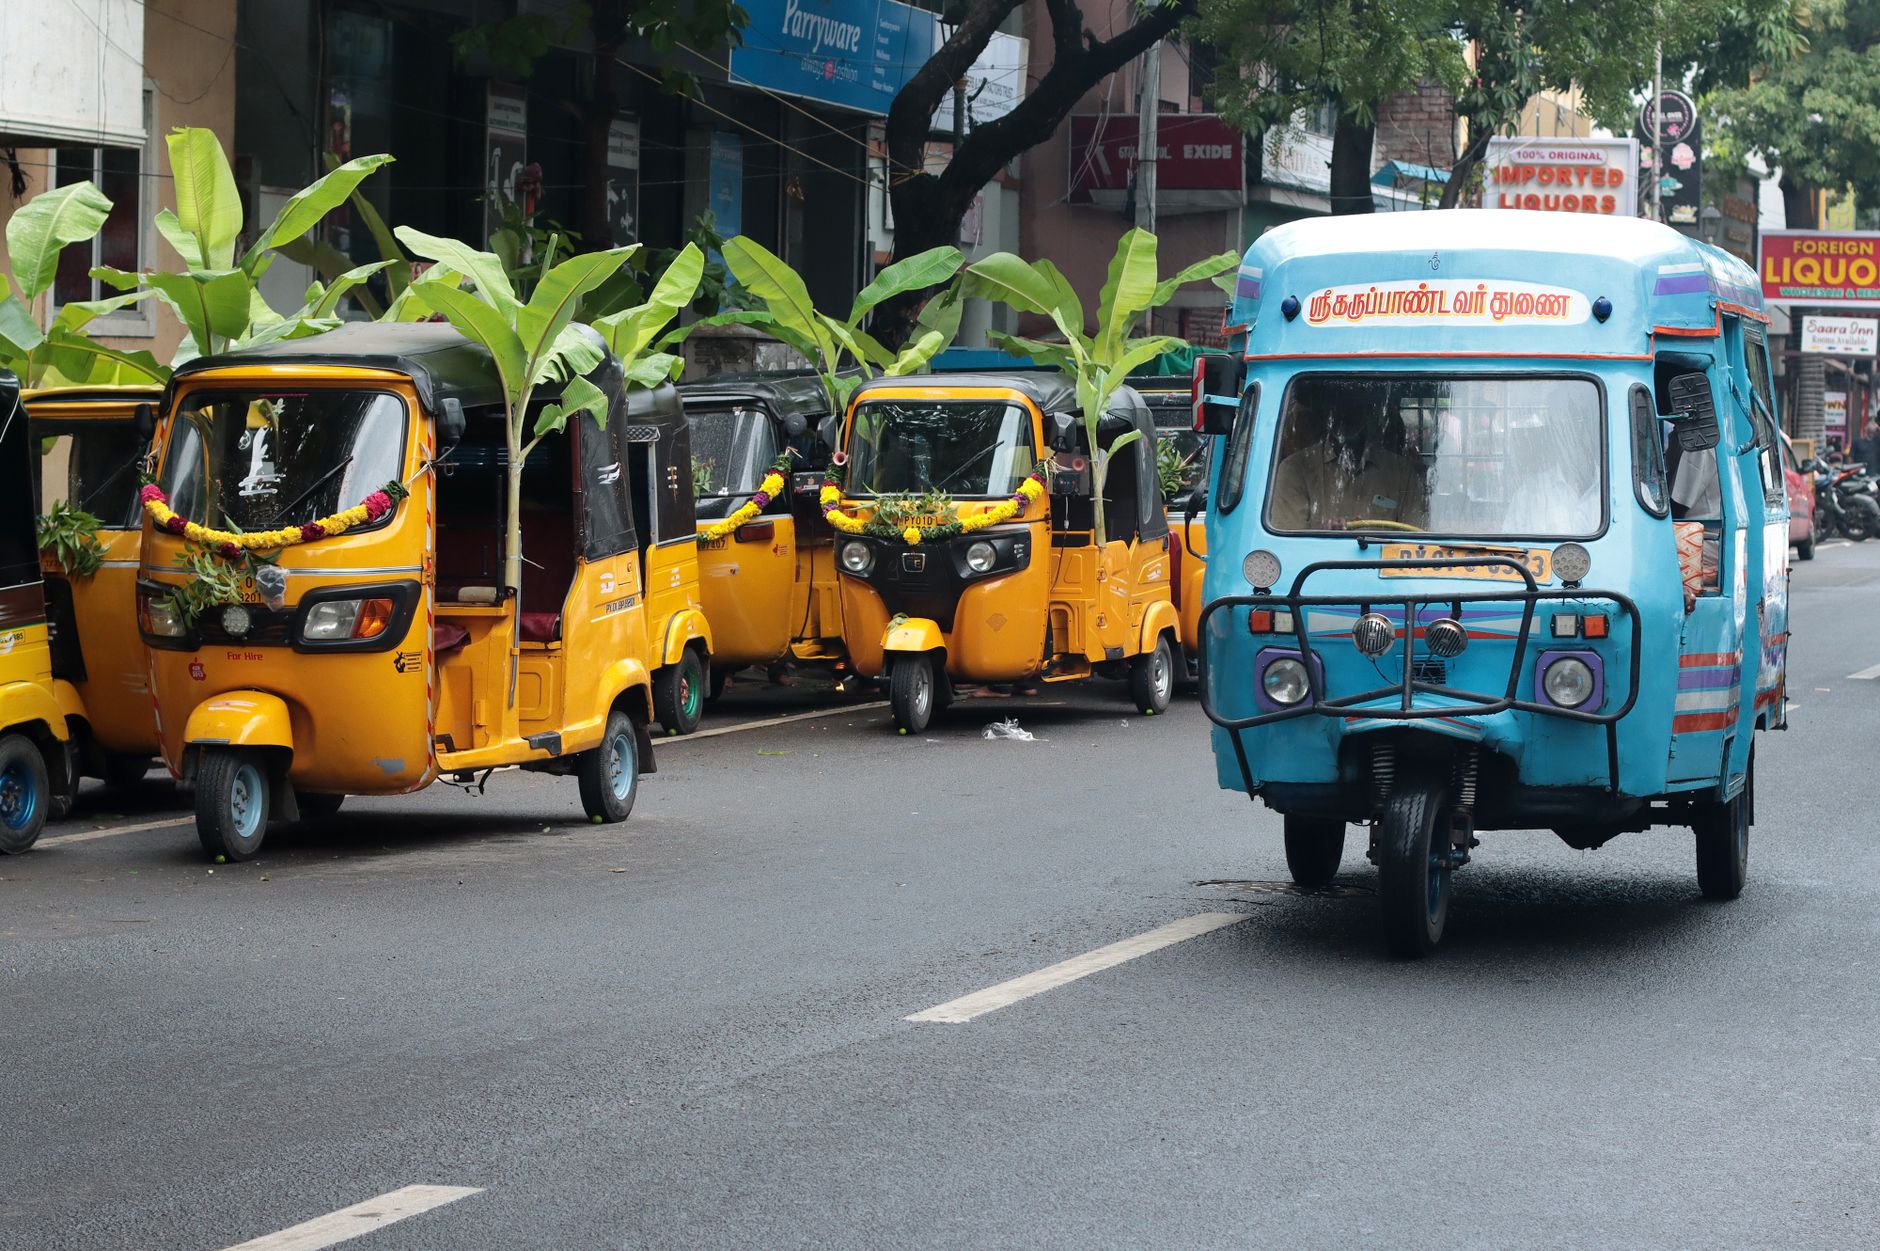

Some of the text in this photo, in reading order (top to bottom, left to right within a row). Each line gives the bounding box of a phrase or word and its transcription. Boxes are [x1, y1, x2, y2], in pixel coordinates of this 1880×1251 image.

[782, 0, 861, 53] Parryware
[1184, 145, 1233, 159] EXIDE
[1516, 151, 1603, 160] 100% ORIGINAL
[1493, 165, 1624, 187] IMPORTED
[1500, 193, 1617, 214] LIQUORS
[1793, 240, 1874, 255] FOREIGN
[1766, 257, 1880, 285] LIQUO
[1780, 287, 1844, 297] WHOLESALE
[1846, 288, 1856, 298] &
[1490, 289, 1572, 322] துணை
[1807, 319, 1874, 336] Saara Inn
[227, 651, 263, 661] For Hire
